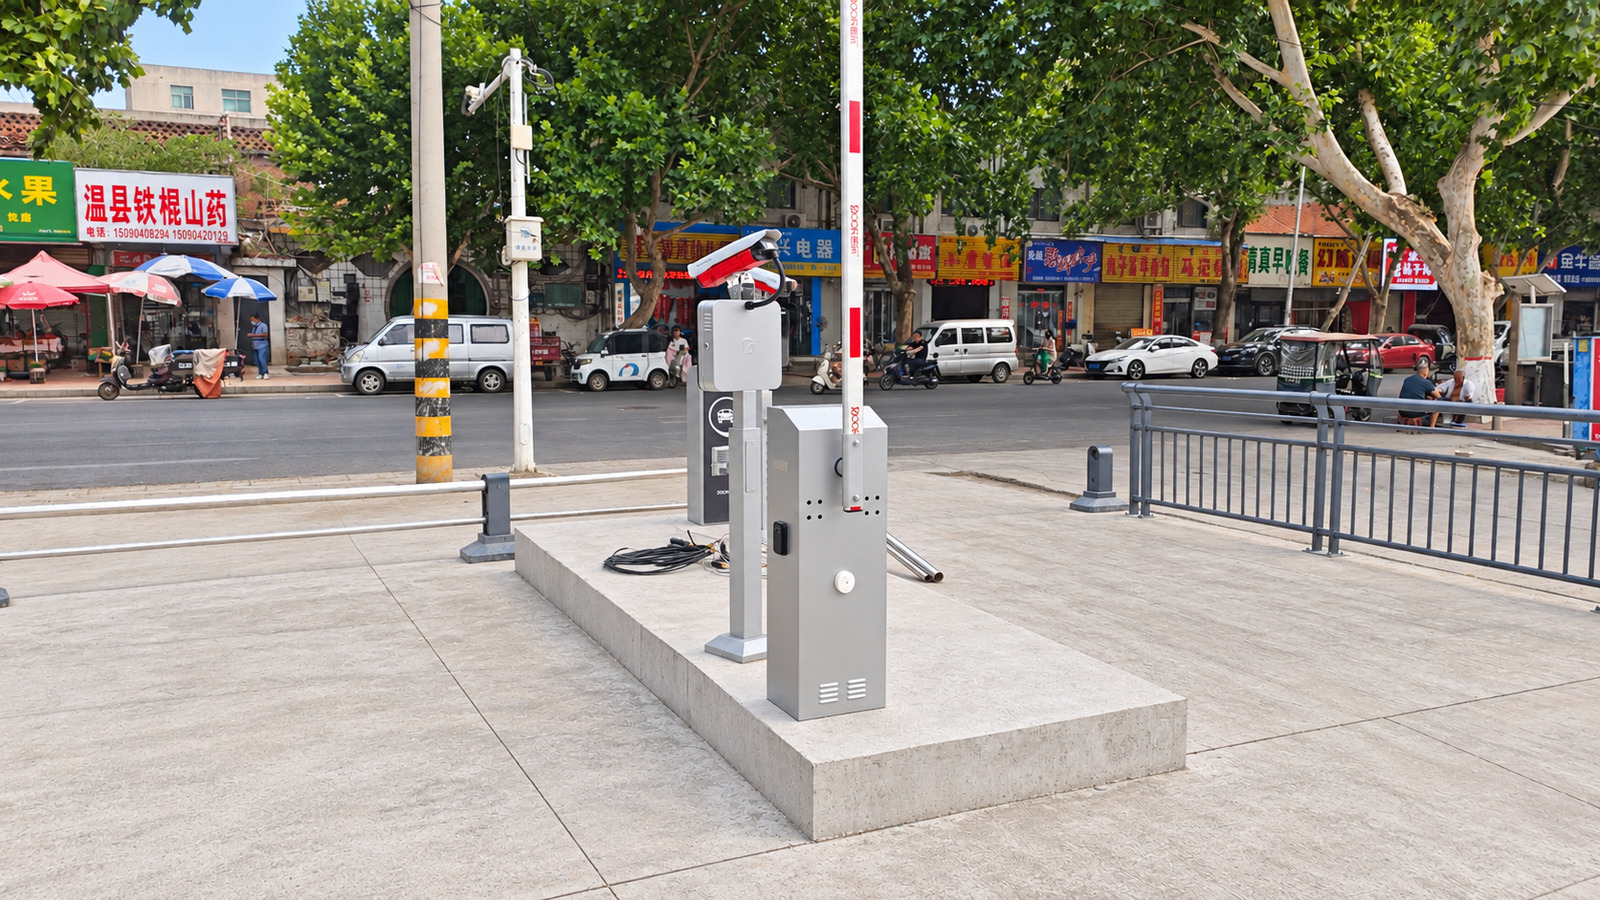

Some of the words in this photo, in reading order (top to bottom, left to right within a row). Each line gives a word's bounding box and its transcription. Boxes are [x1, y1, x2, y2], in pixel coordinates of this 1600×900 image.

[84, 184, 227, 228] 温县铁棍山药
[113, 228, 170, 239] 15090408294
[172, 230, 228, 241] 15090420129
